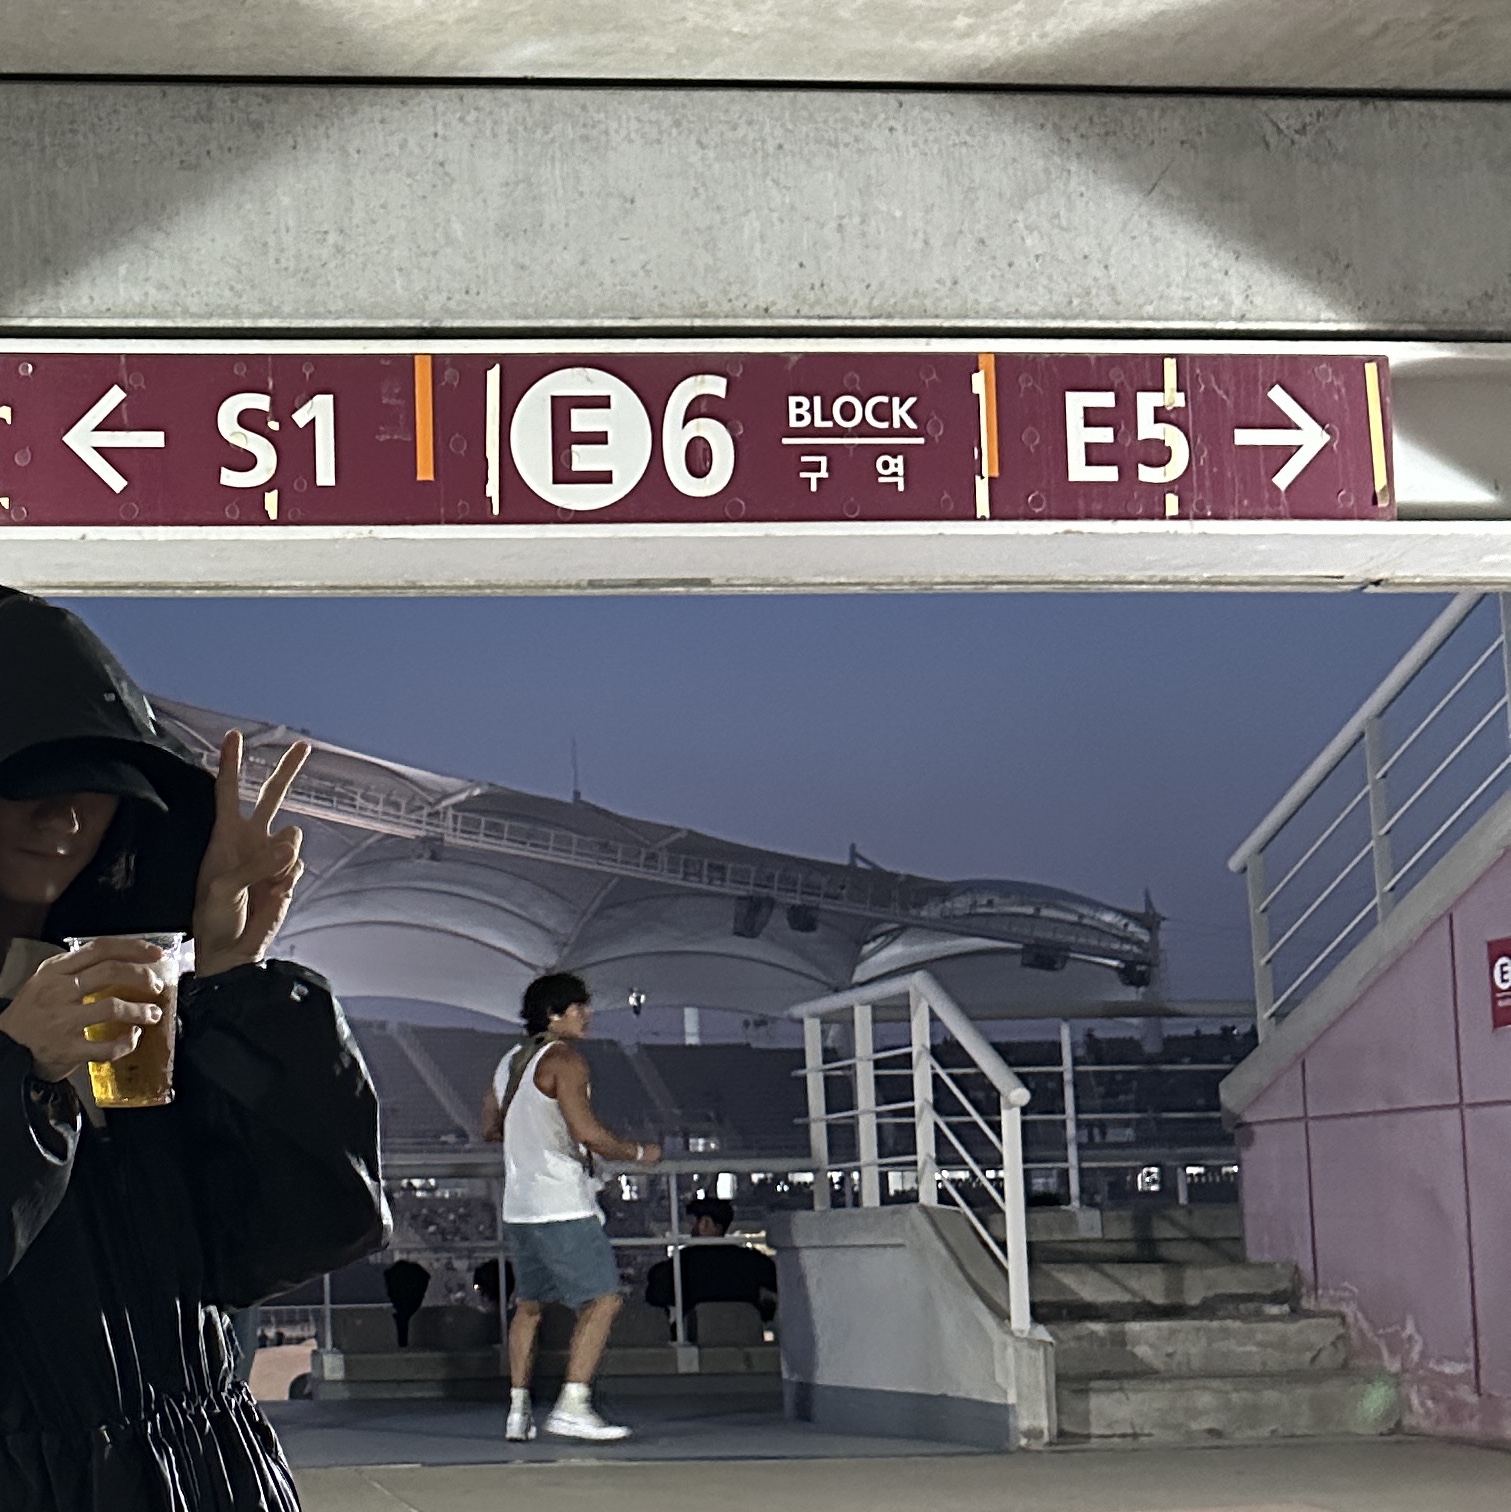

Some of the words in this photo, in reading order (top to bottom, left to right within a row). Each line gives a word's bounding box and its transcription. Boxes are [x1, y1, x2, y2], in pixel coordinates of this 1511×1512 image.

[217, 392, 336, 488] S1
[788, 394, 919, 430] BLOCK
[1064, 390, 1191, 484] E5
